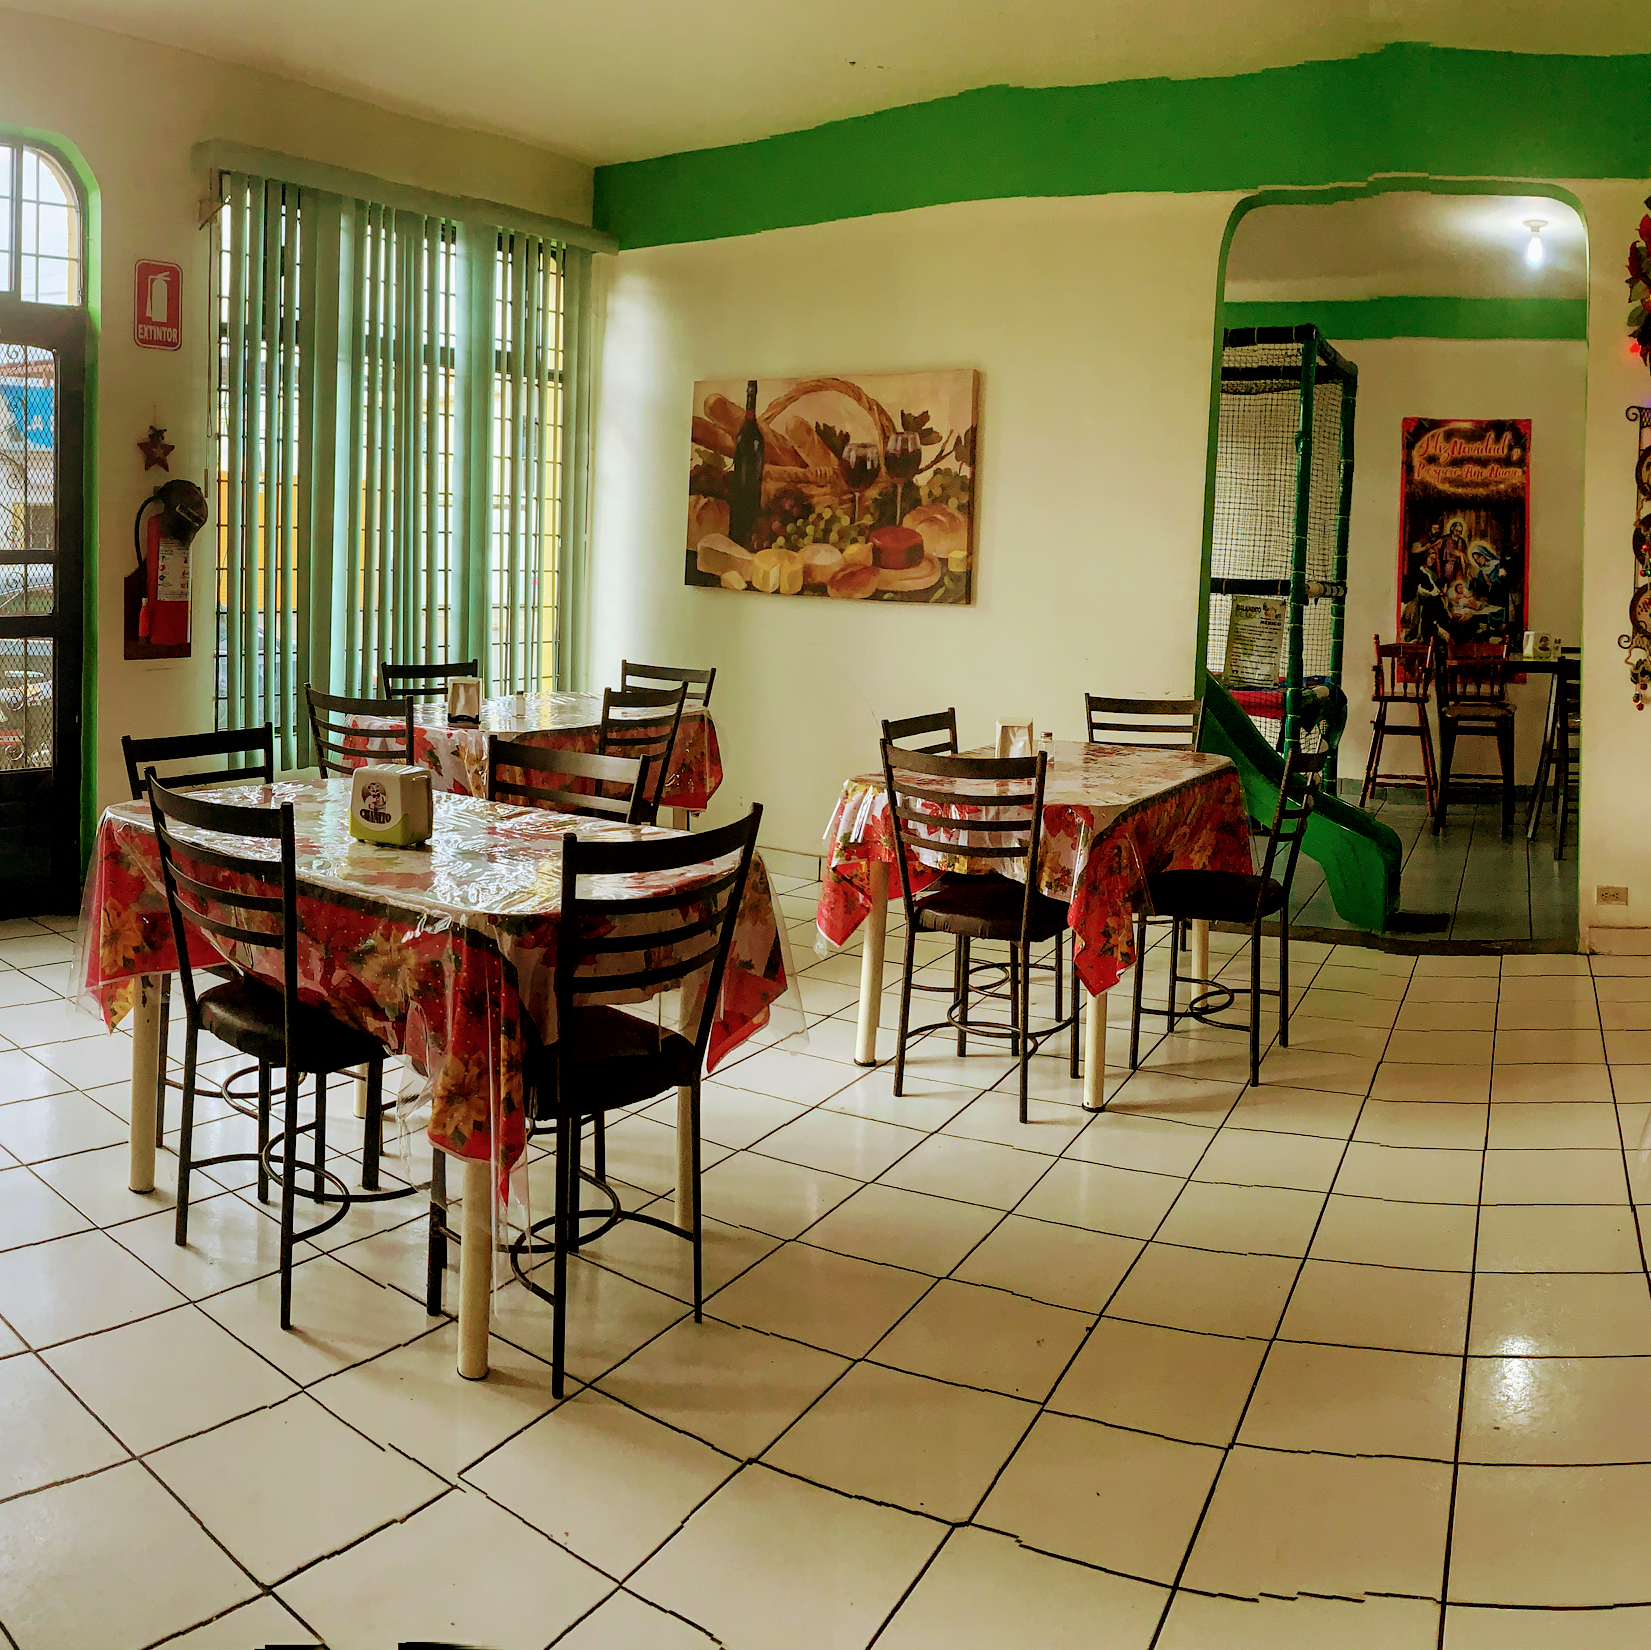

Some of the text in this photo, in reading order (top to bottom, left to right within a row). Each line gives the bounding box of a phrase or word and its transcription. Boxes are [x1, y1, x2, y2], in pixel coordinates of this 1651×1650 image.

[138, 324, 178, 343] EXTINTOR
[1418, 431, 1450, 462] Fliz
[1451, 431, 1509, 456] Navidad
